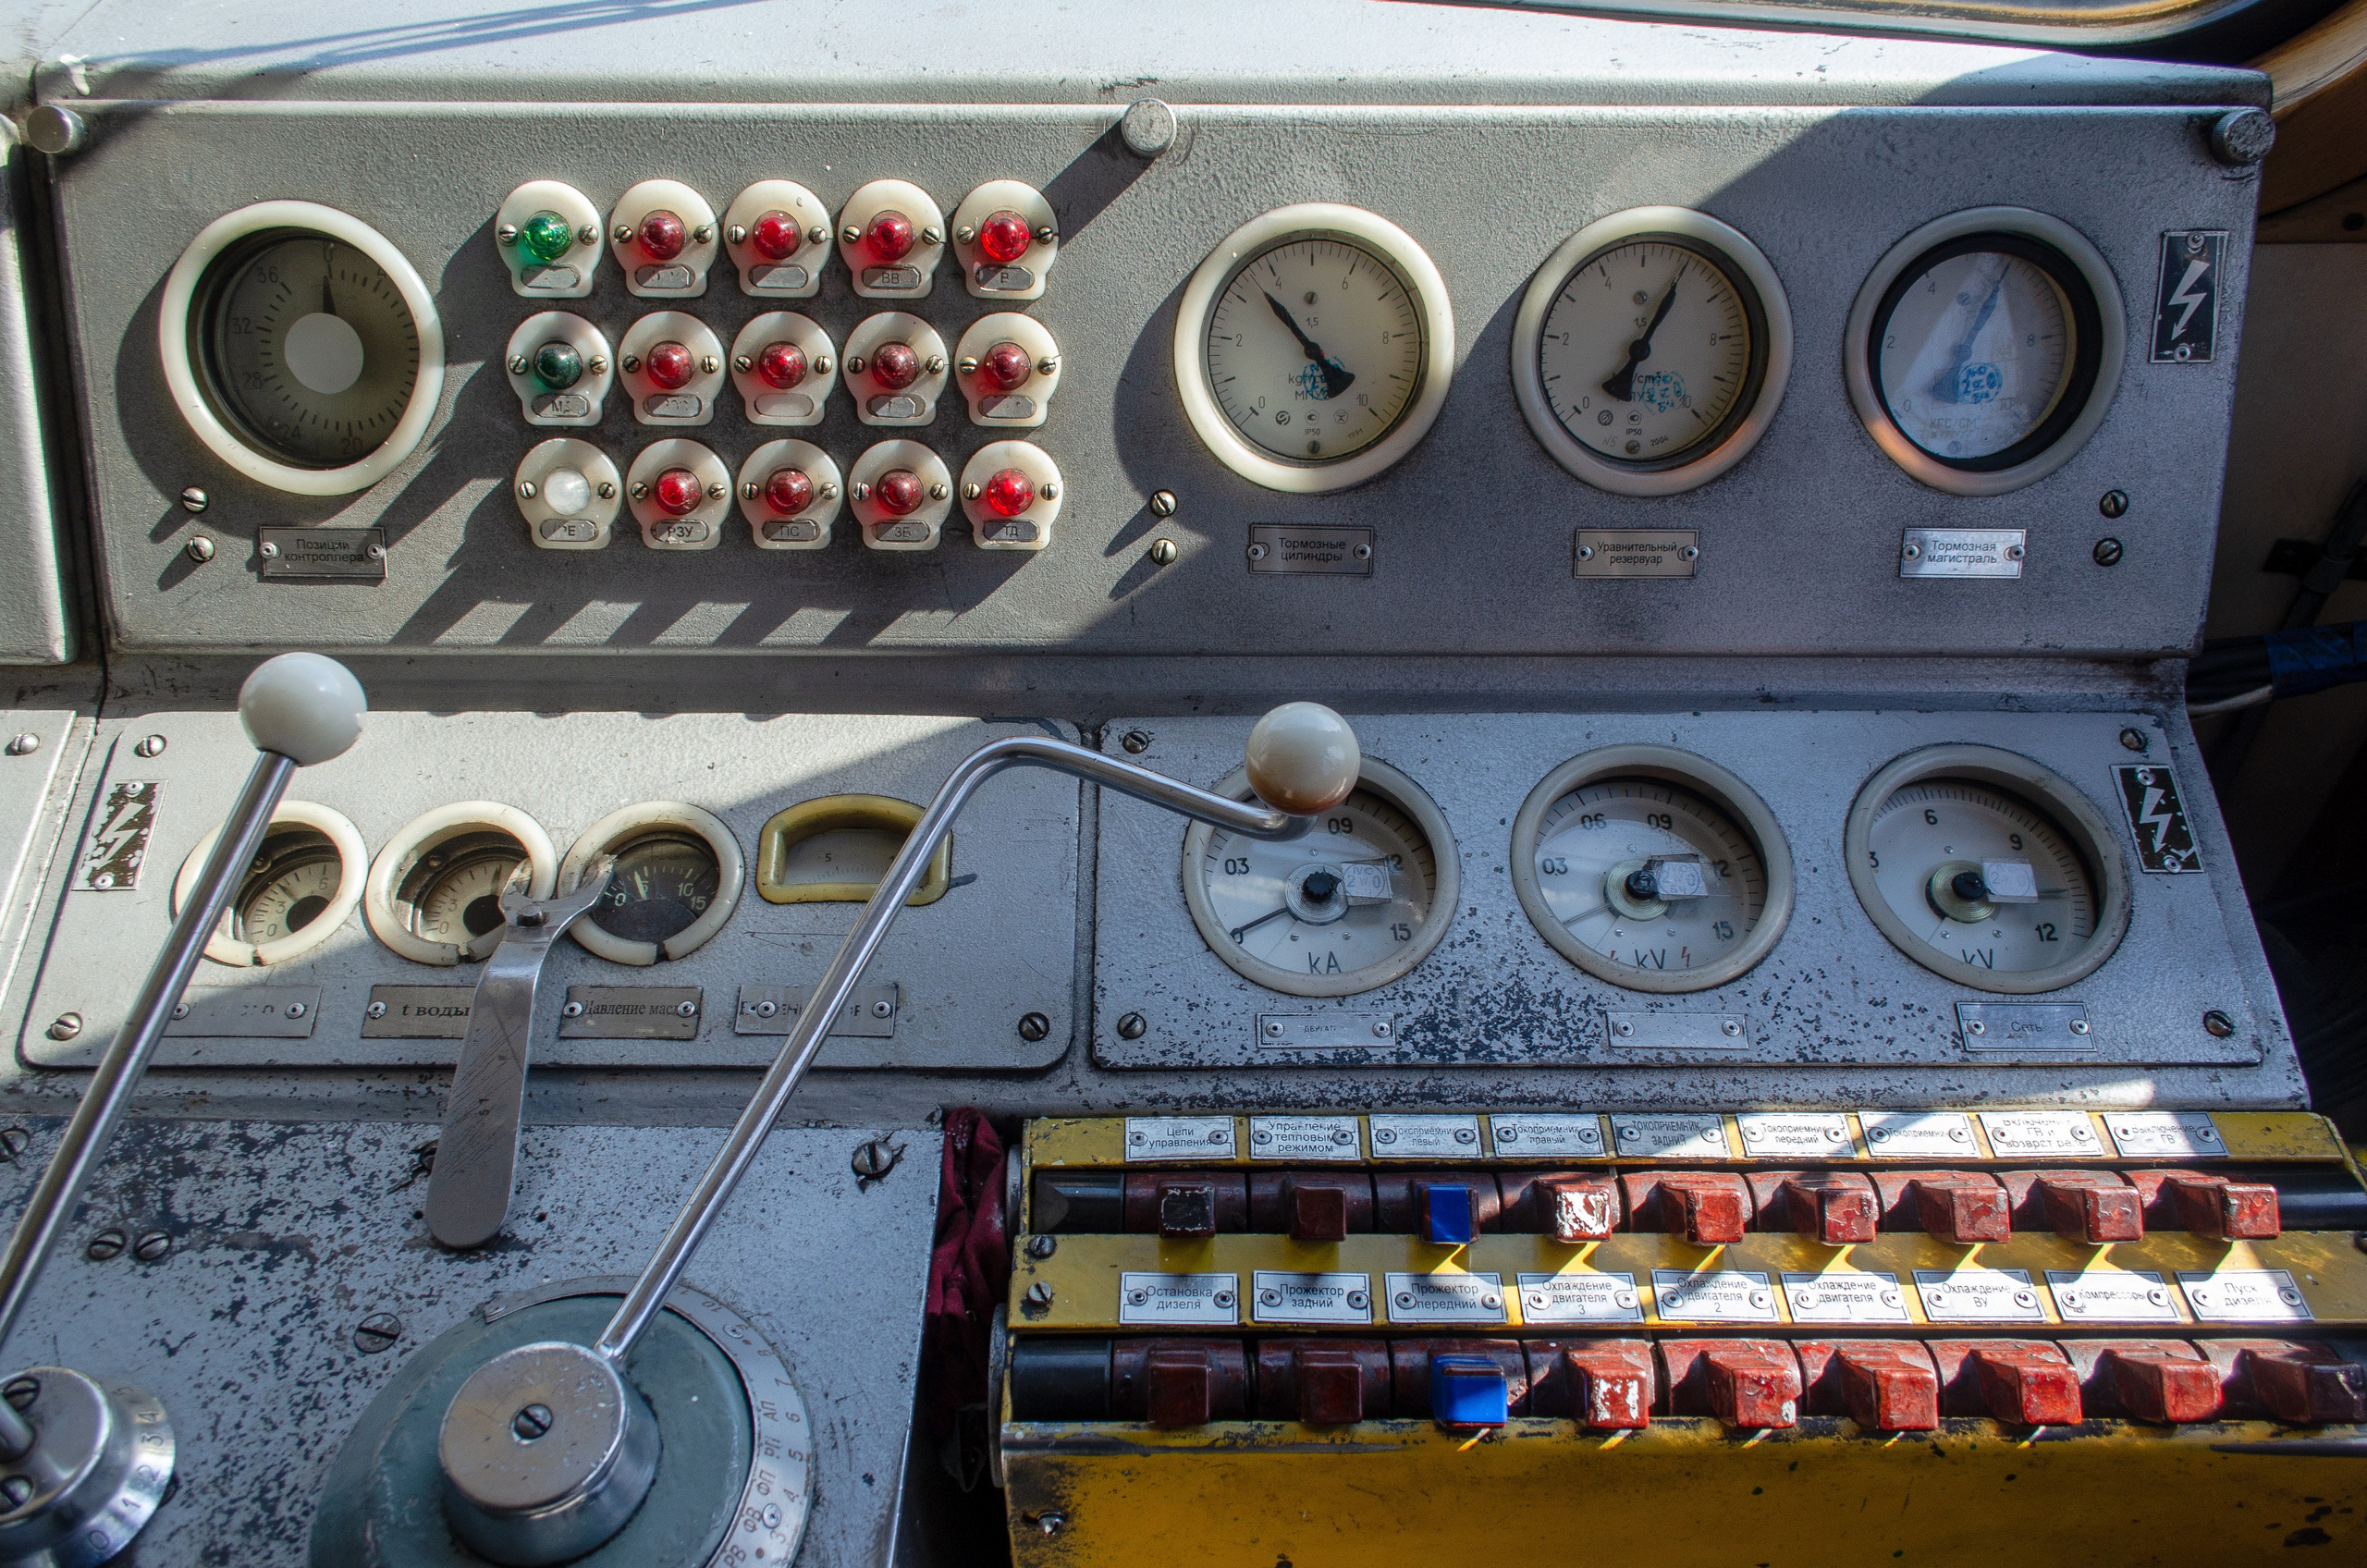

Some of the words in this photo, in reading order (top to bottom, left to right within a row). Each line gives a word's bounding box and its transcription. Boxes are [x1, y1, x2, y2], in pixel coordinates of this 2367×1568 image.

[881, 272, 900, 284] ВВ
[1274, 276, 1282, 290] 4
[1342, 278, 1349, 290] 6
[1604, 276, 1613, 290] 4
[1927, 281, 1936, 295] 4
[1305, 316, 1319, 329] 1,5
[1633, 316, 1648, 329] 1,5
[1235, 333, 1244, 348] 2
[1381, 331, 1390, 345] 8
[1562, 332, 1571, 346] 2
[1710, 333, 1718, 347] 8
[1886, 336, 1895, 349] 2
[2027, 334, 2034, 347] 8
[1257, 396, 1267, 409] 0
[1355, 393, 1368, 407] 10
[1582, 396, 1591, 409] 0
[1679, 395, 1692, 409] 10
[1903, 398, 1911, 412] 0
[1304, 428, 1321, 436] IP50
[1346, 427, 1365, 441] 1991
[1625, 428, 1642, 436] IP50
[1650, 435, 1669, 447] 2004
[668, 525, 693, 538] РЗУ
[780, 526, 800, 537] ПС
[1004, 527, 1019, 538] ТД
[297, 539, 350, 553] Позиции
[1279, 538, 1346, 549] Тормозные
[1597, 542, 1677, 555] Уравнительный
[1932, 541, 1996, 553] Тормозная
[285, 554, 364, 565] контроллера
[1282, 552, 1343, 563] цилиндры
[1610, 556, 1663, 566] резервуар
[1927, 555, 1997, 565] магистраль
[1924, 809, 1938, 826] 6
[2009, 833, 2023, 851] 9
[825, 852, 832, 862] 5
[1869, 851, 1880, 868] 3
[318, 876, 329, 890] 6
[678, 882, 694, 897] 10
[448, 899, 458, 913] 3
[614, 892, 626, 907] 0
[690, 895, 706, 911] 15
[276, 900, 286, 914] 3
[266, 924, 276, 937] 0
[439, 922, 449, 935] 0
[2034, 923, 2058, 942] 12
[1308, 950, 1342, 974] kA
[1634, 948, 1666, 970] kV
[416, 1005, 469, 1018] воды
[582, 1000, 645, 1015] Давление
[2010, 1022, 2042, 1033] Сеть
[1166, 1127, 1195, 1137] Цепи
[1274, 1133, 1334, 1142] тепловым
[1887, 1128, 1948, 1138] Токоприемни
[2027, 1128, 2043, 1137] ГВ
[1148, 1139, 1212, 1150] управления
[1775, 1134, 1819, 1145] передний
[2160, 1134, 2176, 1145] ГВ
[1278, 1145, 1333, 1153] режимом
[1281, 1284, 1344, 1297] Прожектор
[1412, 1283, 1478, 1296] Прожектор
[1542, 1280, 1613, 1292] Охлаждение
[1677, 1278, 1748, 1291] Охлаждение
[1808, 1279, 1877, 1292] Охлаждение
[1942, 1282, 2011, 1295] Охлаждение
[2224, 1283, 2258, 1295] Пуск
[1147, 1286, 1213, 1297] Остановка
[1687, 1292, 1743, 1303] двигателя
[1157, 1299, 1201, 1310] дизеля
[1292, 1297, 1333, 1309] задний
[1417, 1298, 1477, 1311] передний
[1552, 1294, 1607, 1305] двигателя
[1819, 1292, 1874, 1305] двигателя
[1973, 1296, 1988, 1307] ВУ
[1578, 1305, 1586, 1315] 3
[1714, 1303, 1722, 1313] 2
[761, 1400, 779, 1423] АП
[785, 1411, 801, 1423] 6
[141, 1434, 165, 1448] 3
[788, 1448, 803, 1462] 5
[137, 1464, 161, 1482] 2
[756, 1468, 776, 1496] ФП
[783, 1488, 799, 1502] 4
[743, 1506, 762, 1533] ФВ
[89, 1529, 110, 1551] 0
